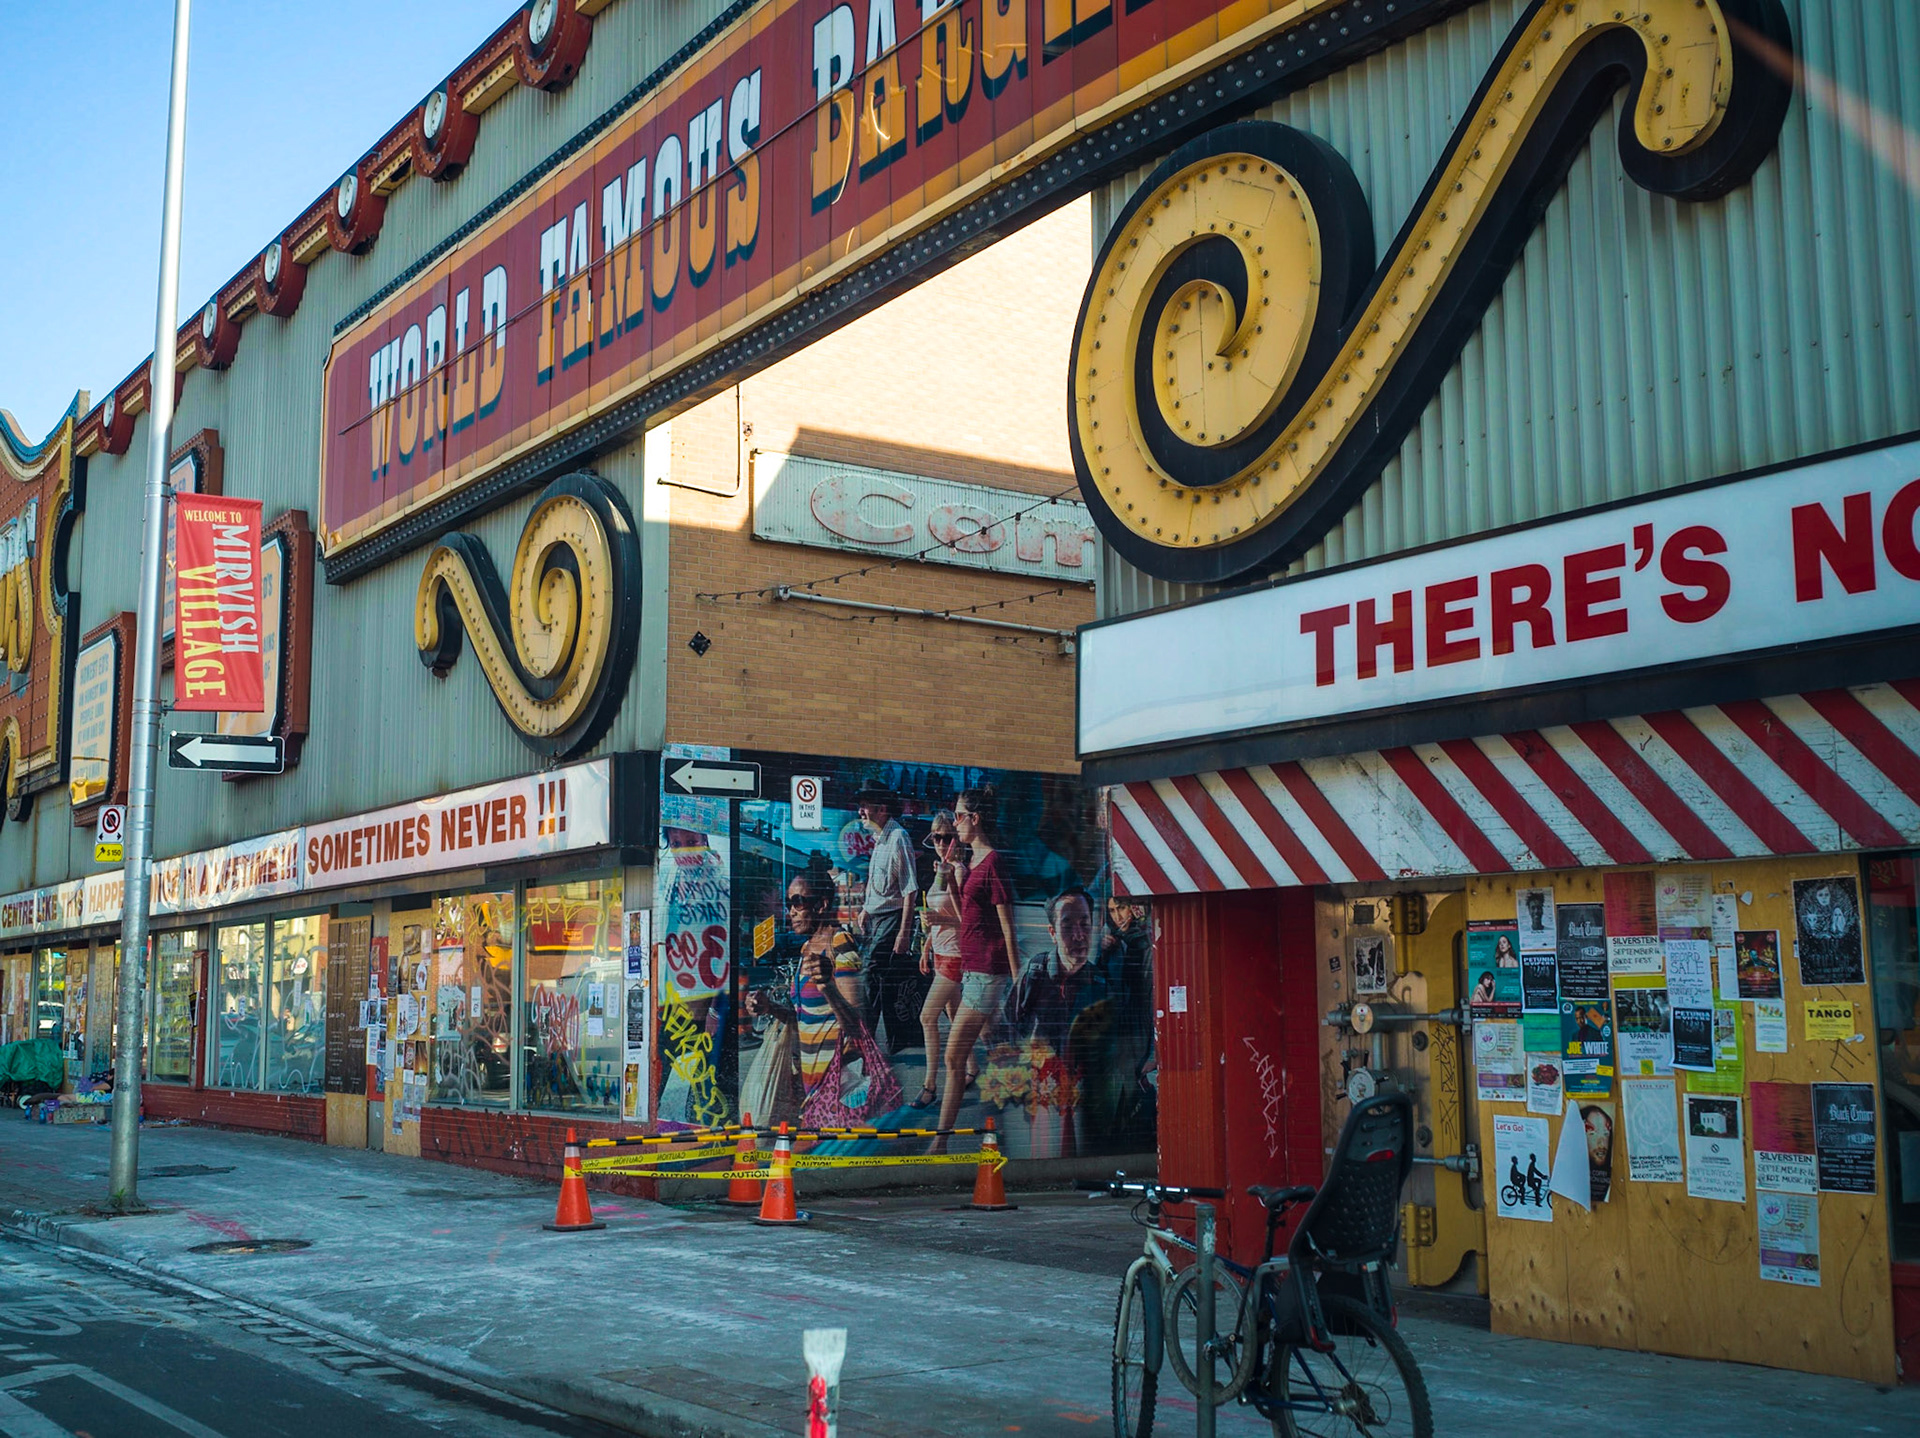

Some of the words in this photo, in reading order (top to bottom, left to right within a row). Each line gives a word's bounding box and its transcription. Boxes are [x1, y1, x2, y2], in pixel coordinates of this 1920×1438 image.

[367, 264, 507, 482] WORLD
[537, 67, 762, 387] FAMOUS
[184, 509, 227, 523] WELCOME
[229, 512, 242, 523] TO
[212, 523, 259, 654] MIRVISH
[1300, 522, 1732, 688] THERE'S
[178, 563, 227, 699] VILLAGE
[800, 811, 815, 819] LANE
[307, 812, 430, 875] SOMETIMES
[440, 793, 527, 853] NEVER
[2, 900, 34, 929] CENTRE
[37, 893, 58, 923] LIKE
[61, 887, 83, 918] THIS
[1612, 936, 1658, 945] SILVERSTEIN
[1523, 956, 1555, 964] PETUNIA
[1670, 951, 1701, 962] RECORD
[1670, 960, 1705, 975] SALE
[1807, 1009, 1852, 1018] TANGO
[1566, 1041, 1583, 1055] JOE
[1583, 1041, 1609, 1055] WHITE
[1496, 1122, 1512, 1131] Let's
[1512, 1124, 1525, 1132] Go!
[1760, 1151, 1813, 1163] SILVERSTEIN
[722, 1170, 770, 1179] CAUTION
